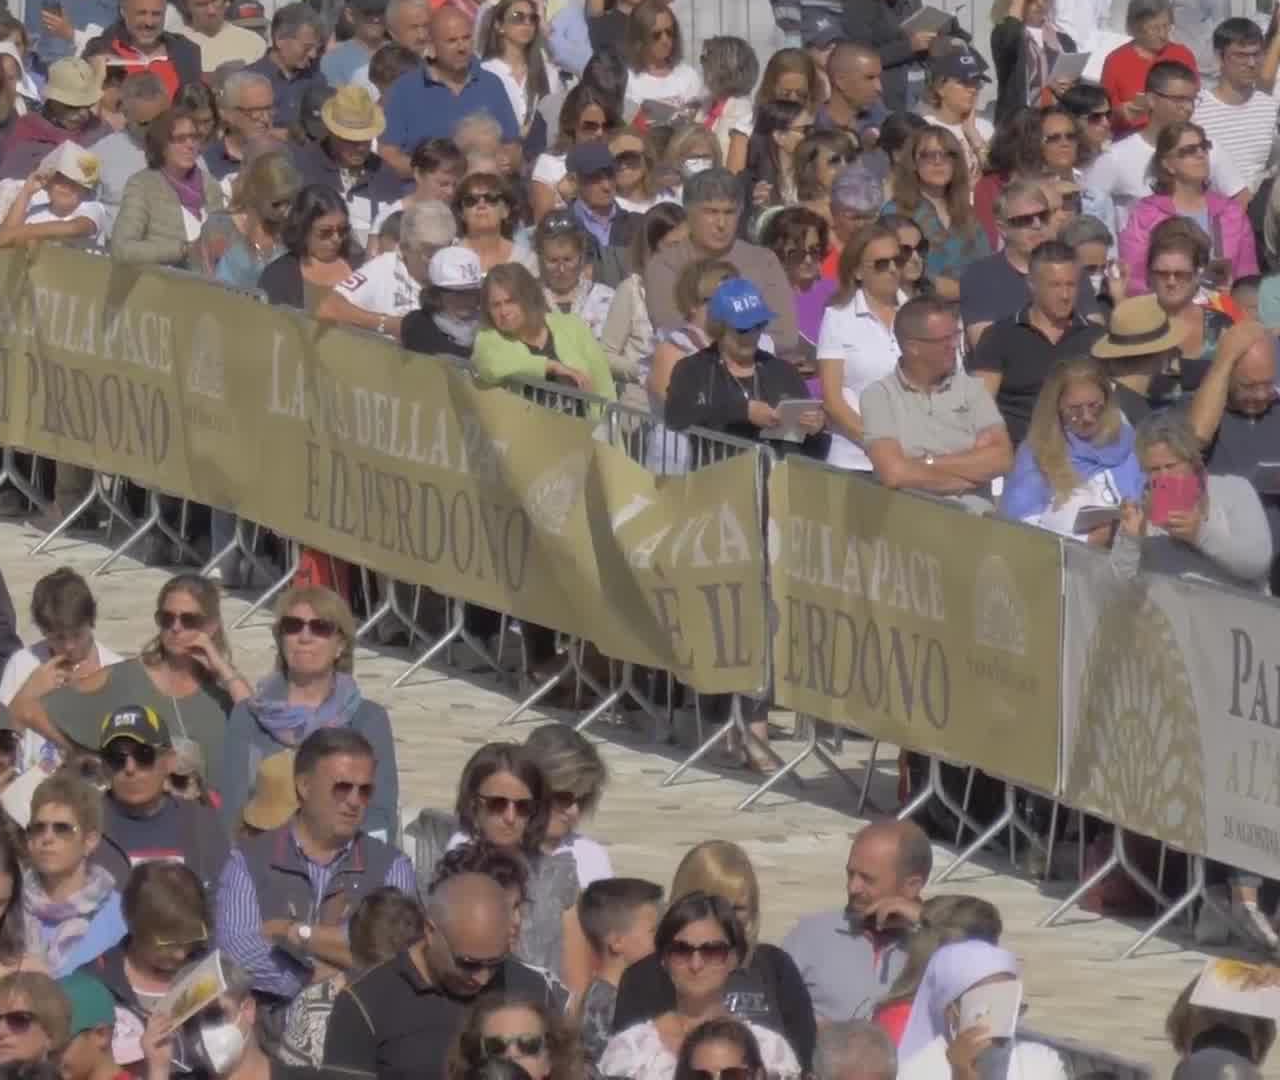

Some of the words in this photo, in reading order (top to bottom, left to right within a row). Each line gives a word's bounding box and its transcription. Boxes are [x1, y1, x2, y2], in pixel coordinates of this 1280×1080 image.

[102, 304, 174, 377] PACE
[269, 328, 306, 419] LA
[352, 385, 450, 468] DELLA
[329, 449, 357, 534] IL
[358, 460, 531, 593] PERDONO
[649, 562, 695, 671] È
[696, 581, 752, 671] IL
[866, 535, 947, 621] PACE
[1228, 627, 1280, 729] PA
